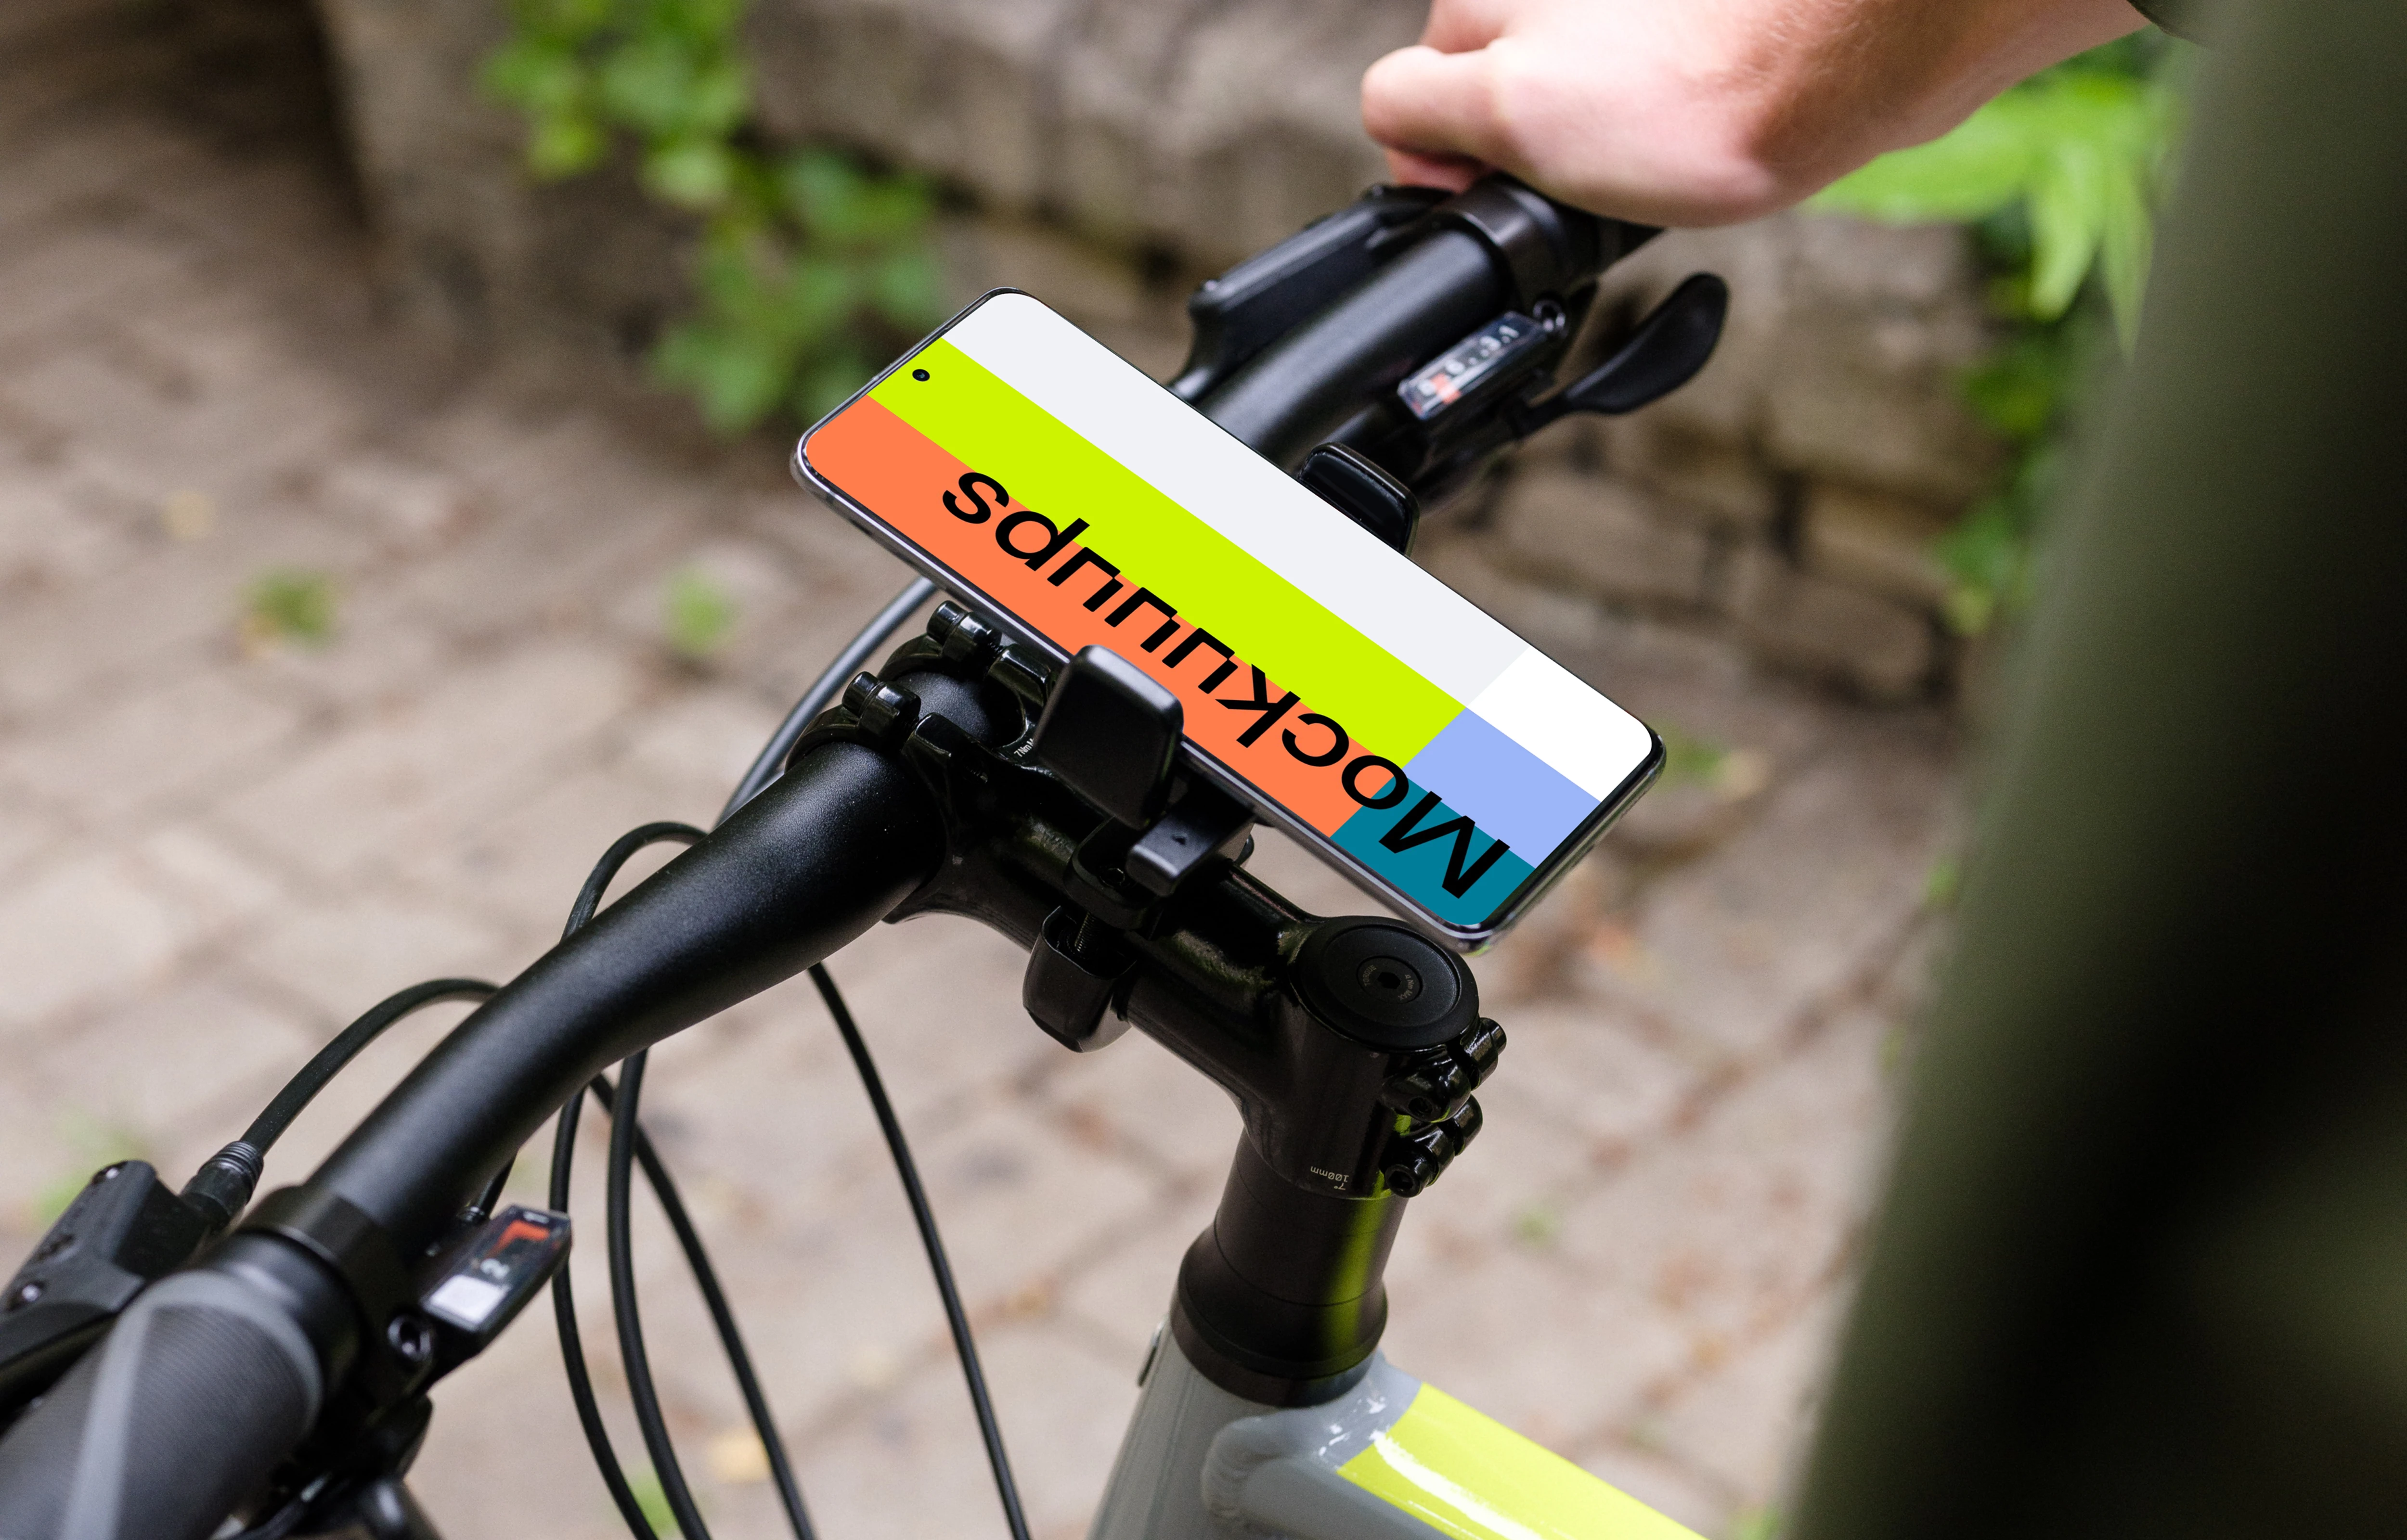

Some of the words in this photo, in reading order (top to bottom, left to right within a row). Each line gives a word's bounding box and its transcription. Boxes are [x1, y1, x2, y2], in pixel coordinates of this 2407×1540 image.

[942, 472, 1511, 899] Mockuuups
[1362, 964, 1377, 987] TORQUE
[1310, 1166, 1349, 1182] 100mm
